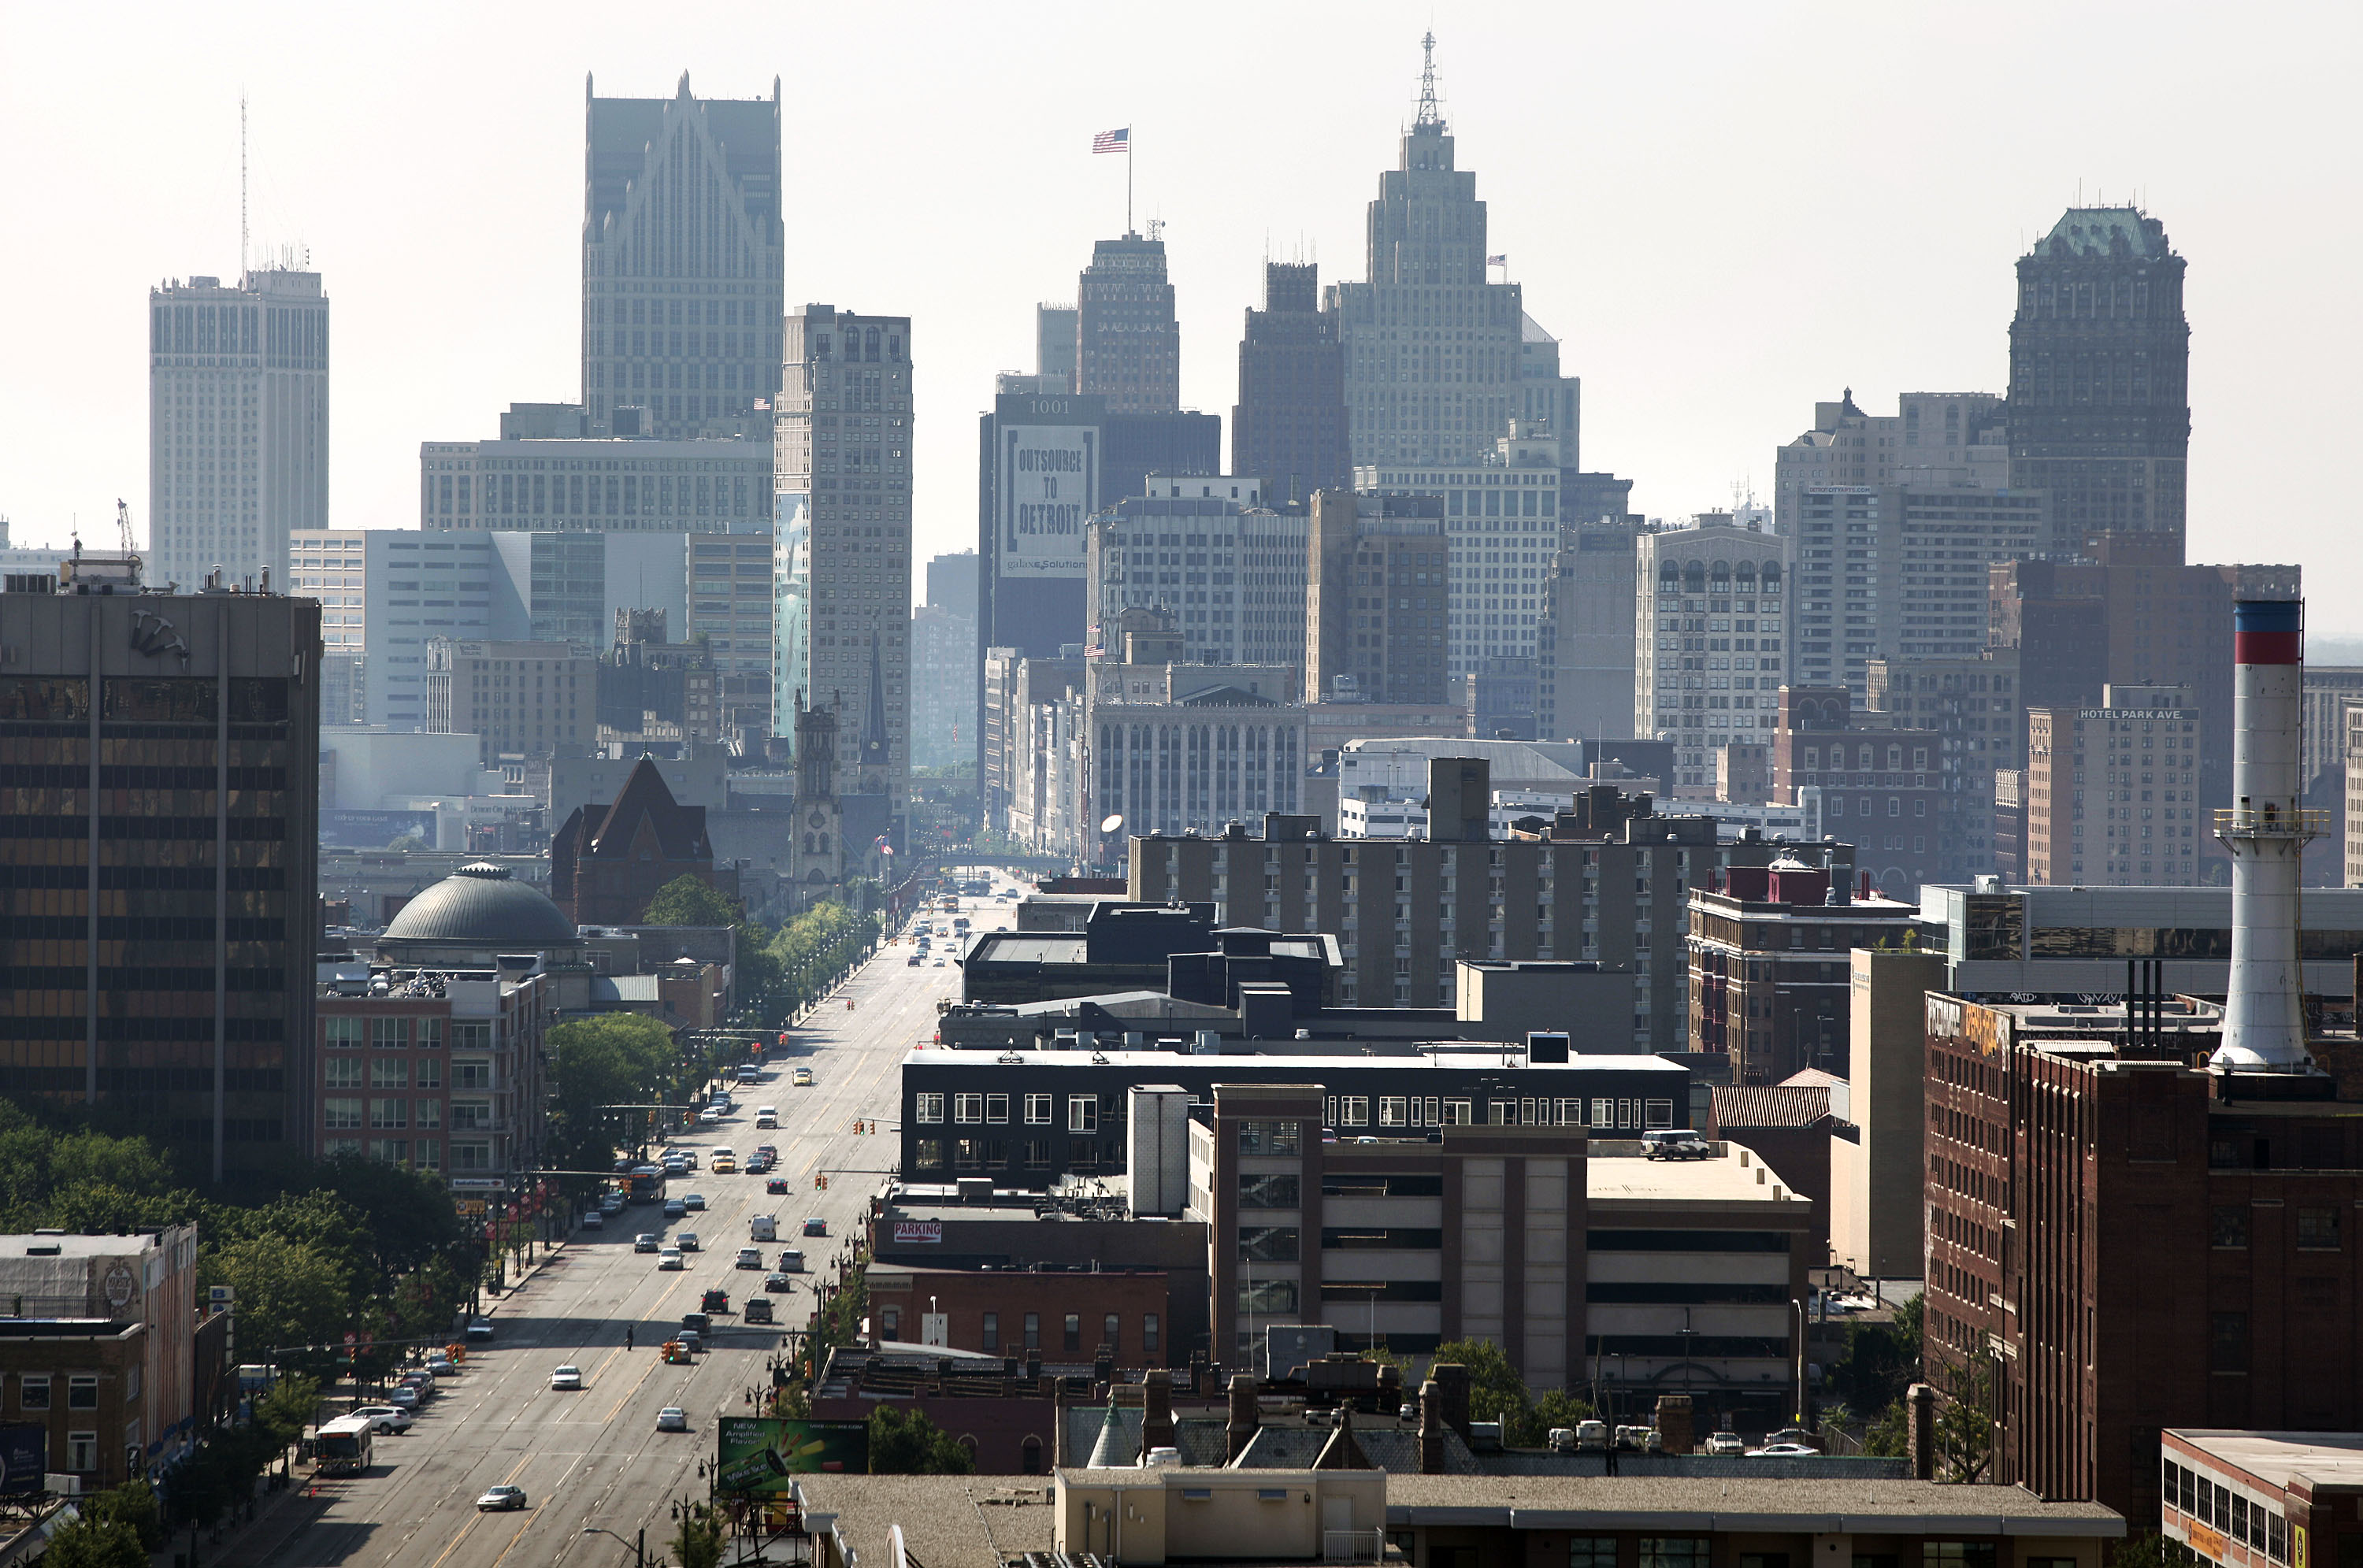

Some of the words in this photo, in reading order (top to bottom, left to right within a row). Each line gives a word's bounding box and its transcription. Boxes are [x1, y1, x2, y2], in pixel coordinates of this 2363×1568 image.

[1029, 400, 1070, 414] 1001
[1019, 449, 1081, 473] OUTSOURCE
[1044, 476, 1058, 499] TO
[1019, 502, 1081, 535] DETROIT
[2080, 710, 2119, 719] HOTEL
[2121, 710, 2153, 719] PARK
[2157, 710, 2183, 719] AVE.
[895, 1223, 941, 1235] PARKING
[725, 1429, 766, 1439] Amplified
